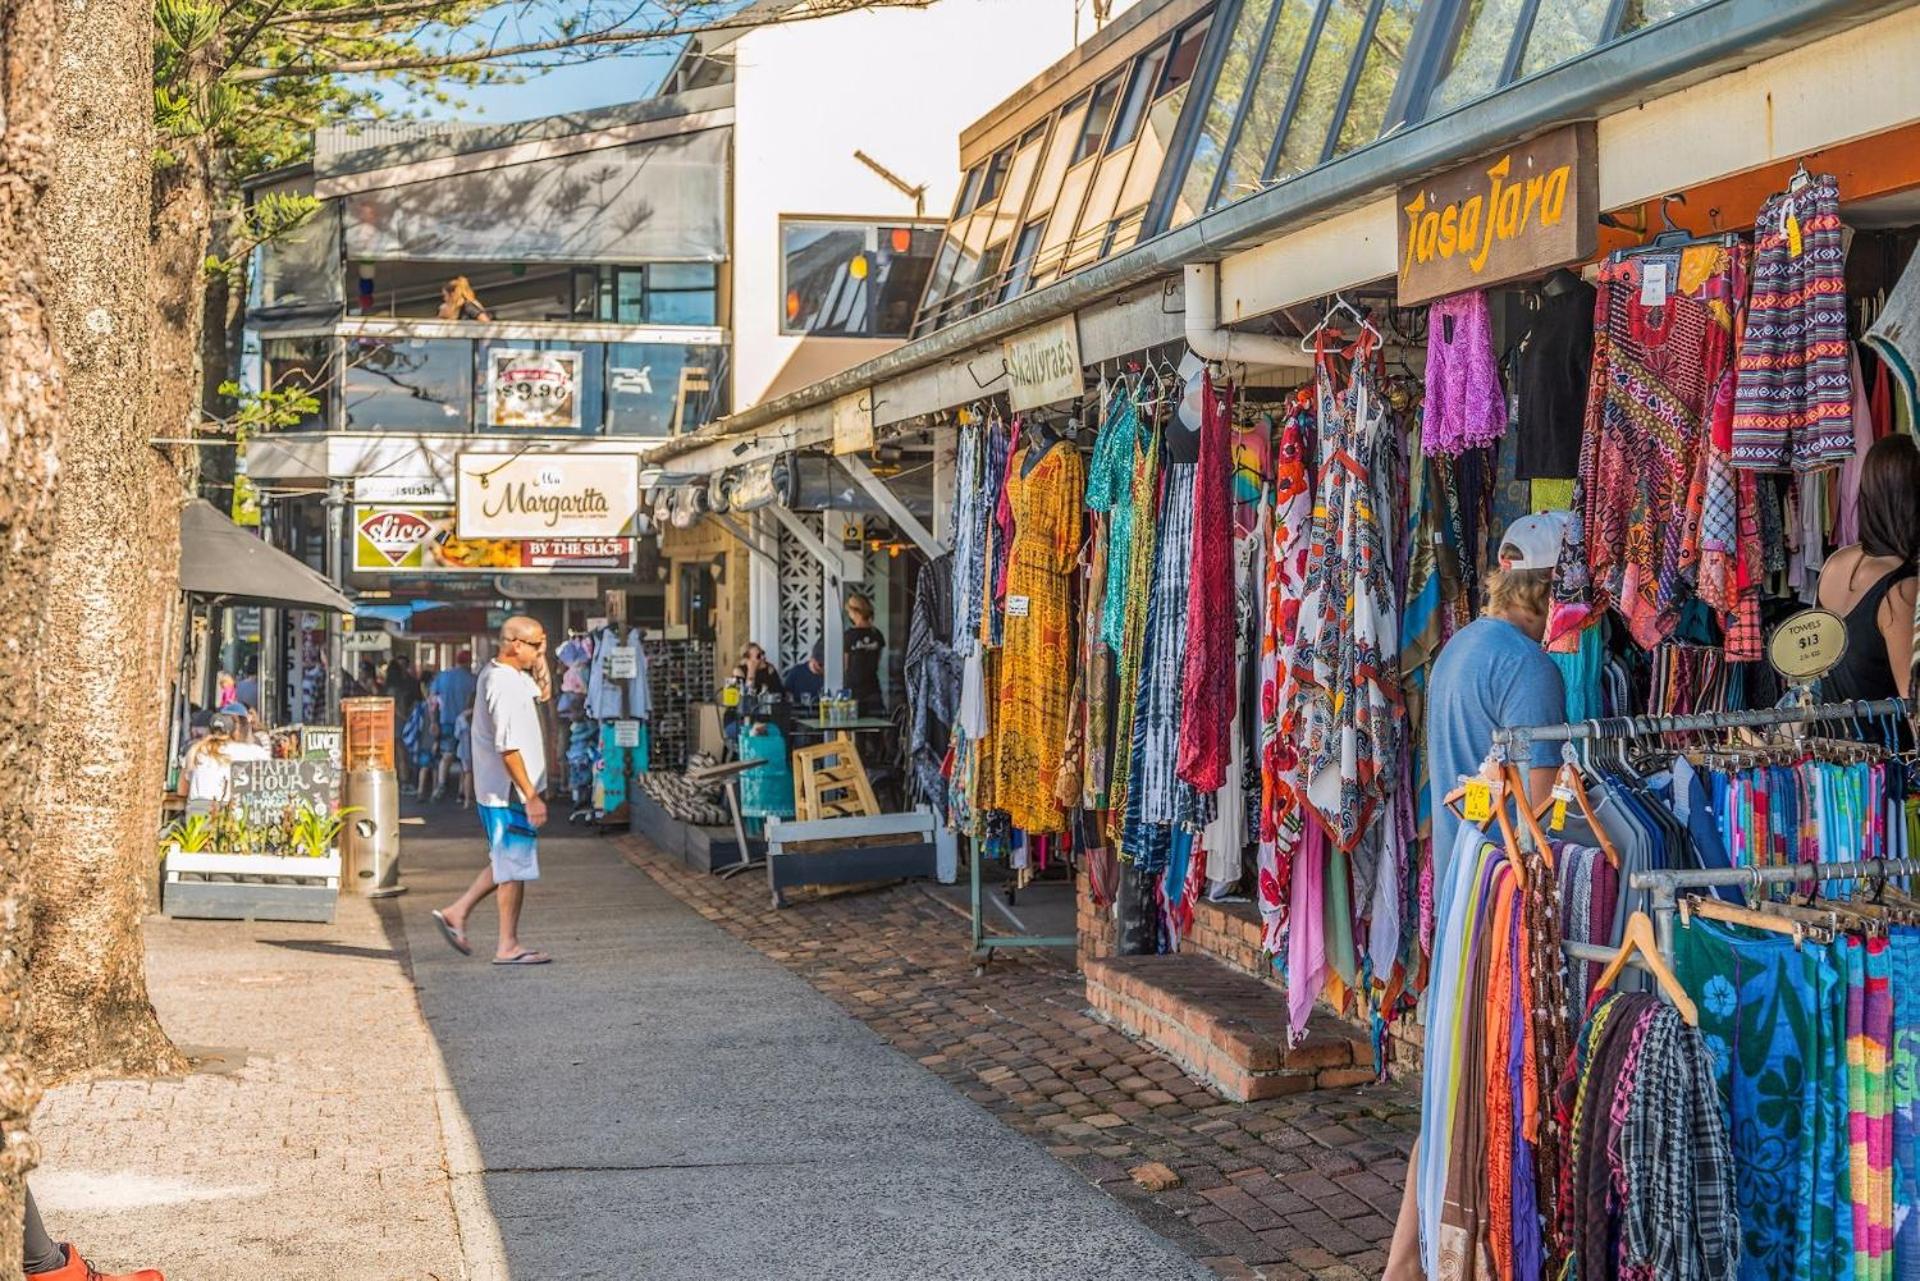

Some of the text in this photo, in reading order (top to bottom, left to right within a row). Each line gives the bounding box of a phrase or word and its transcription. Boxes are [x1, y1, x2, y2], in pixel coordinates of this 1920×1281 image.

[401, 483, 435, 497] sushi
[483, 481, 610, 527] Margarita
[369, 515, 426, 542] slice
[529, 542, 623, 555] BY THE SLICE
[1789, 620, 1821, 634] TOWELS
[1799, 633, 1819, 649] $13
[251, 759, 301, 776] HAPPY
[251, 775, 310, 791] HOUR
